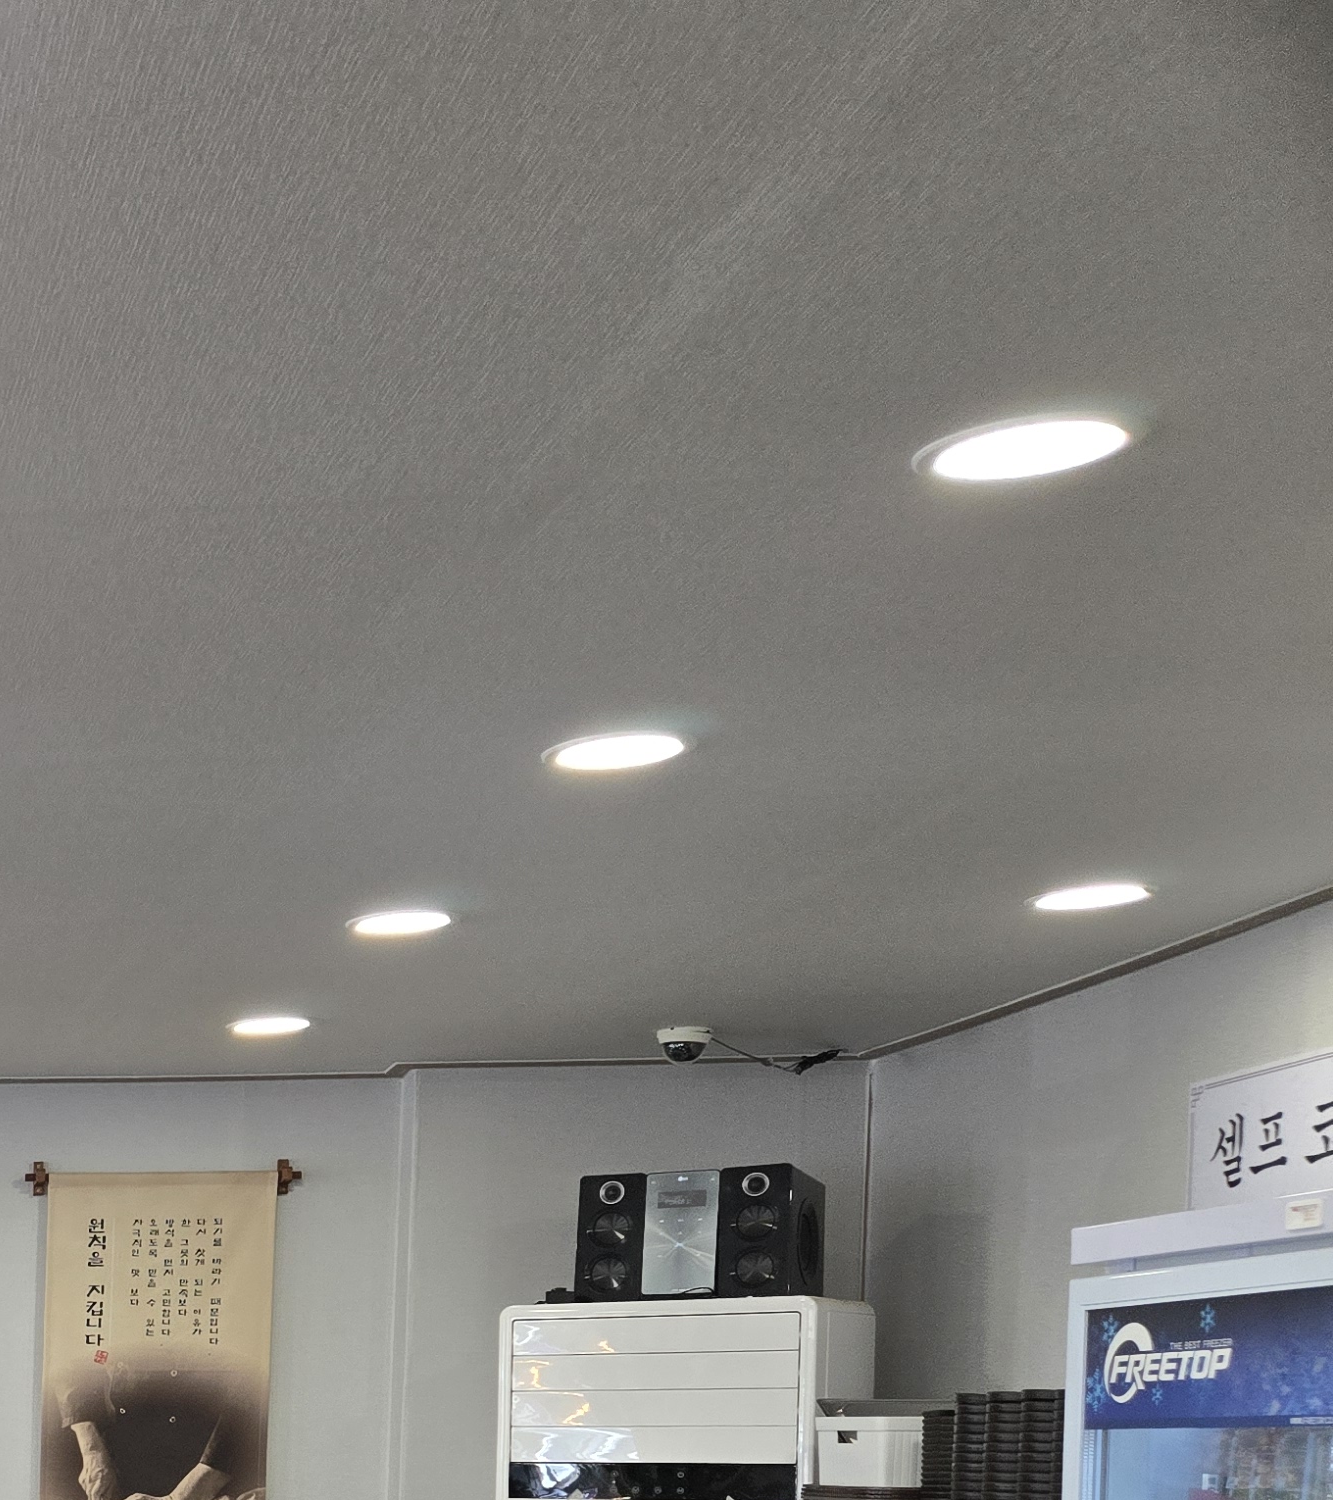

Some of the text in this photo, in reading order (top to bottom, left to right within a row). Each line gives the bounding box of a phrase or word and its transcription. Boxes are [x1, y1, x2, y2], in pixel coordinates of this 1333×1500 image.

[1209, 1111, 1288, 1188] 셀프
[86, 1219, 106, 1346] 원칙을 지킵니다
[1109, 1347, 1233, 1389] FREETOP
[1169, 1338, 1233, 1351] THE BEST FREEZER
